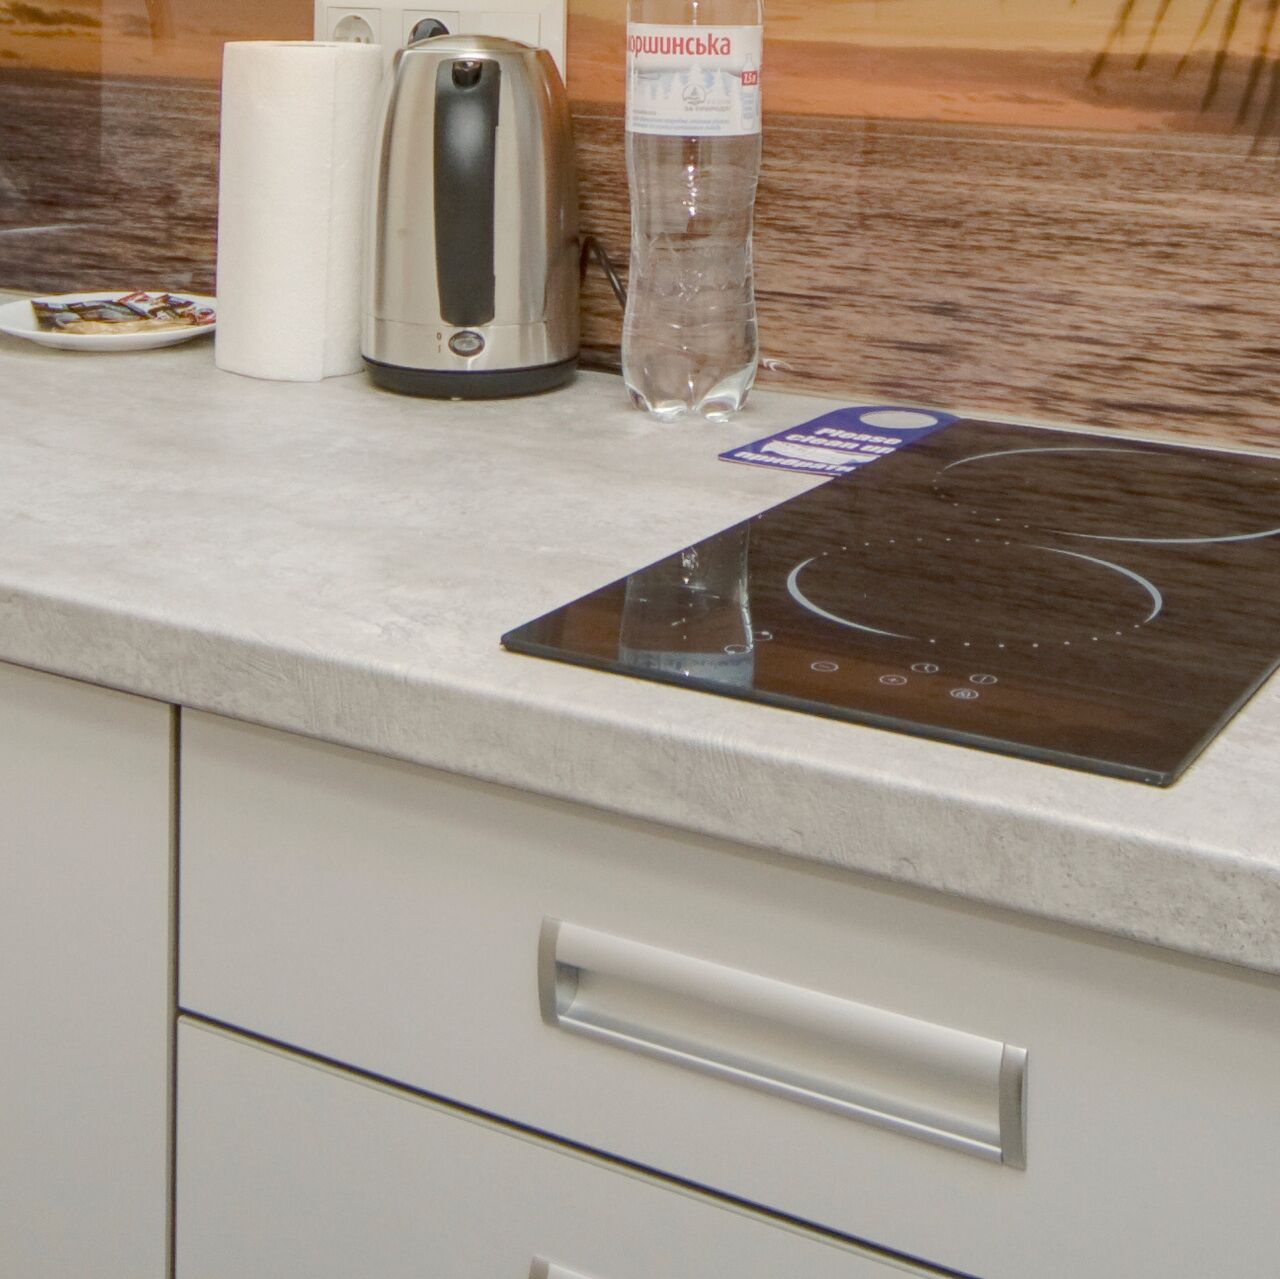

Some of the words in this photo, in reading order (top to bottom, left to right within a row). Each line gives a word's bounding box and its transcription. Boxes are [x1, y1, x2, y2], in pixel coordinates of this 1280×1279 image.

[627, 32, 731, 58] оршинська
[785, 434, 860, 450] clean
[860, 444, 897, 455] up
[814, 427, 903, 445] Please
